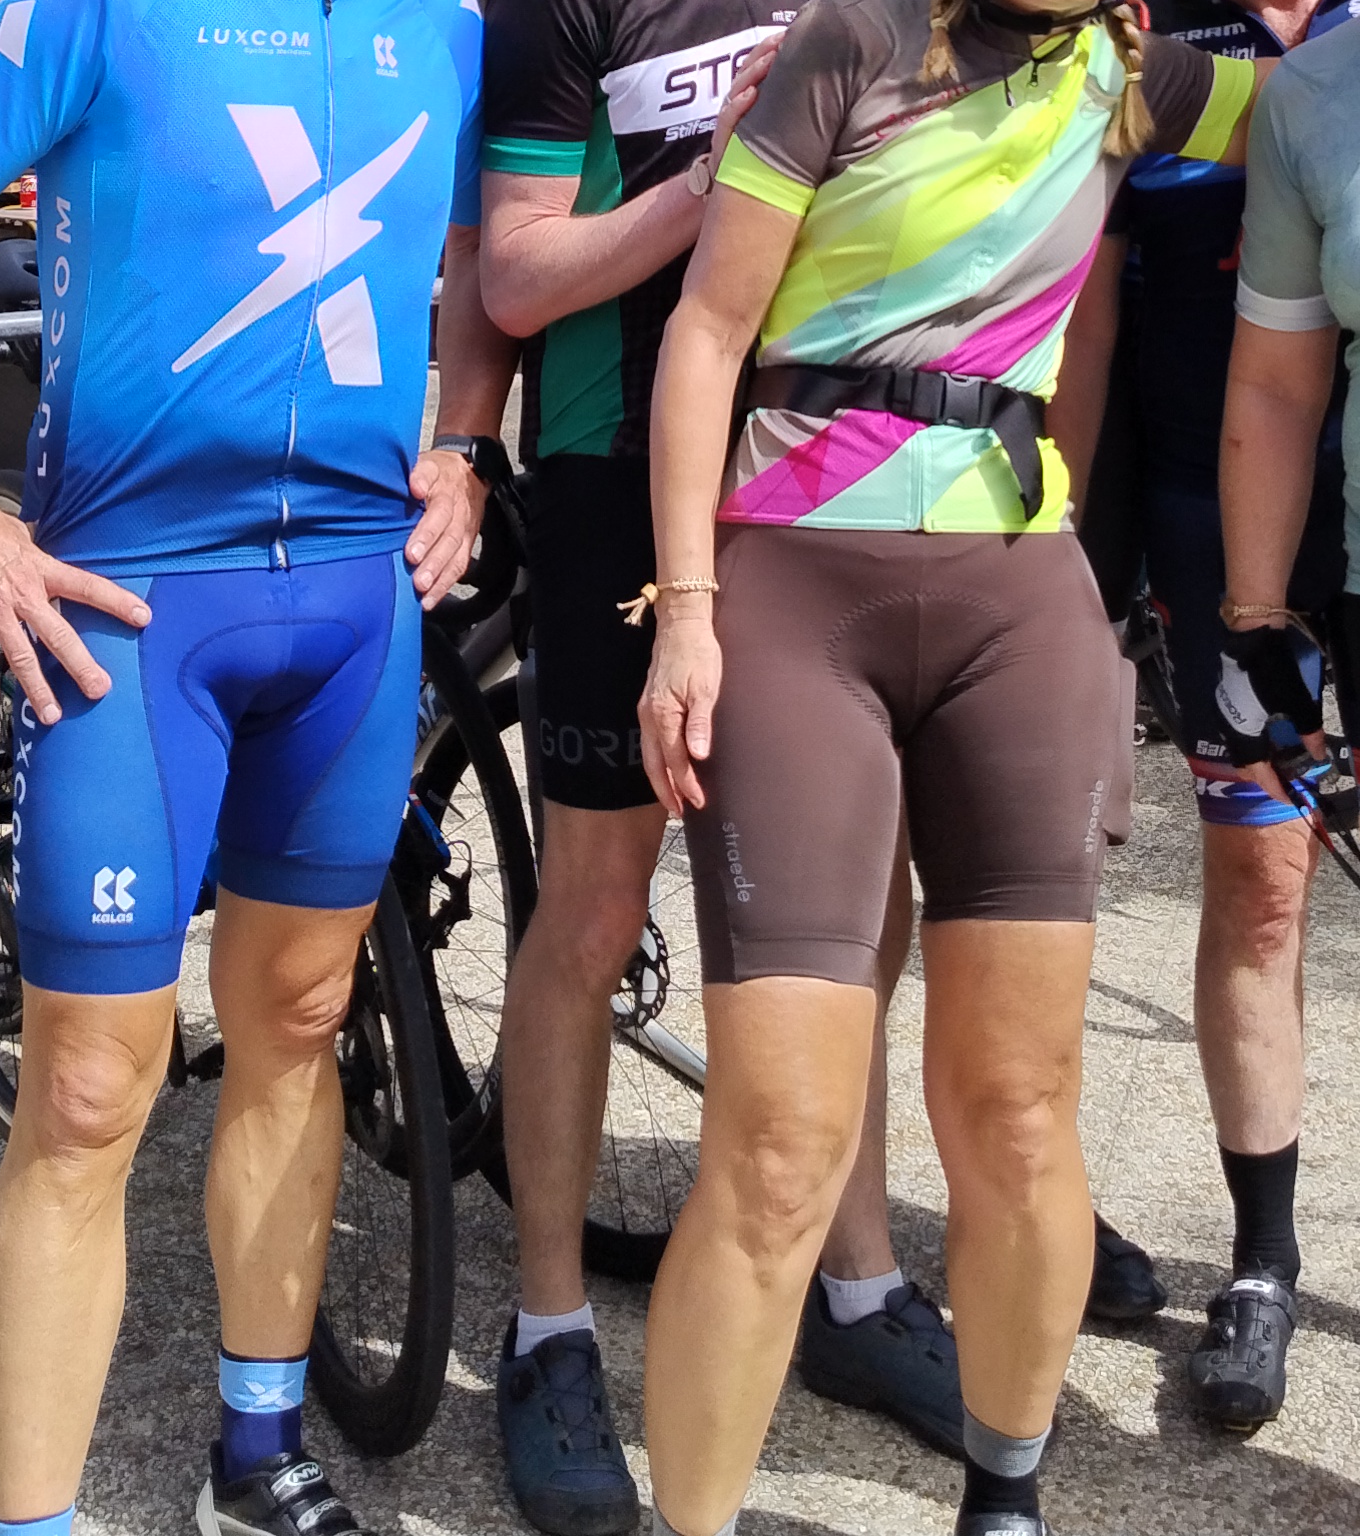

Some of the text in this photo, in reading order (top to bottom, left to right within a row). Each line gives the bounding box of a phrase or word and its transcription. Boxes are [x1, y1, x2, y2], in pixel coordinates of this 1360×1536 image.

[197, 25, 310, 47] LUXCOM
[1169, 22, 1247, 42] SRAM
[664, 118, 718, 142] Stilfse
[37, 196, 72, 477] LUXCOM
[11, 696, 37, 899] UXCOM
[722, 821, 756, 903] straede
